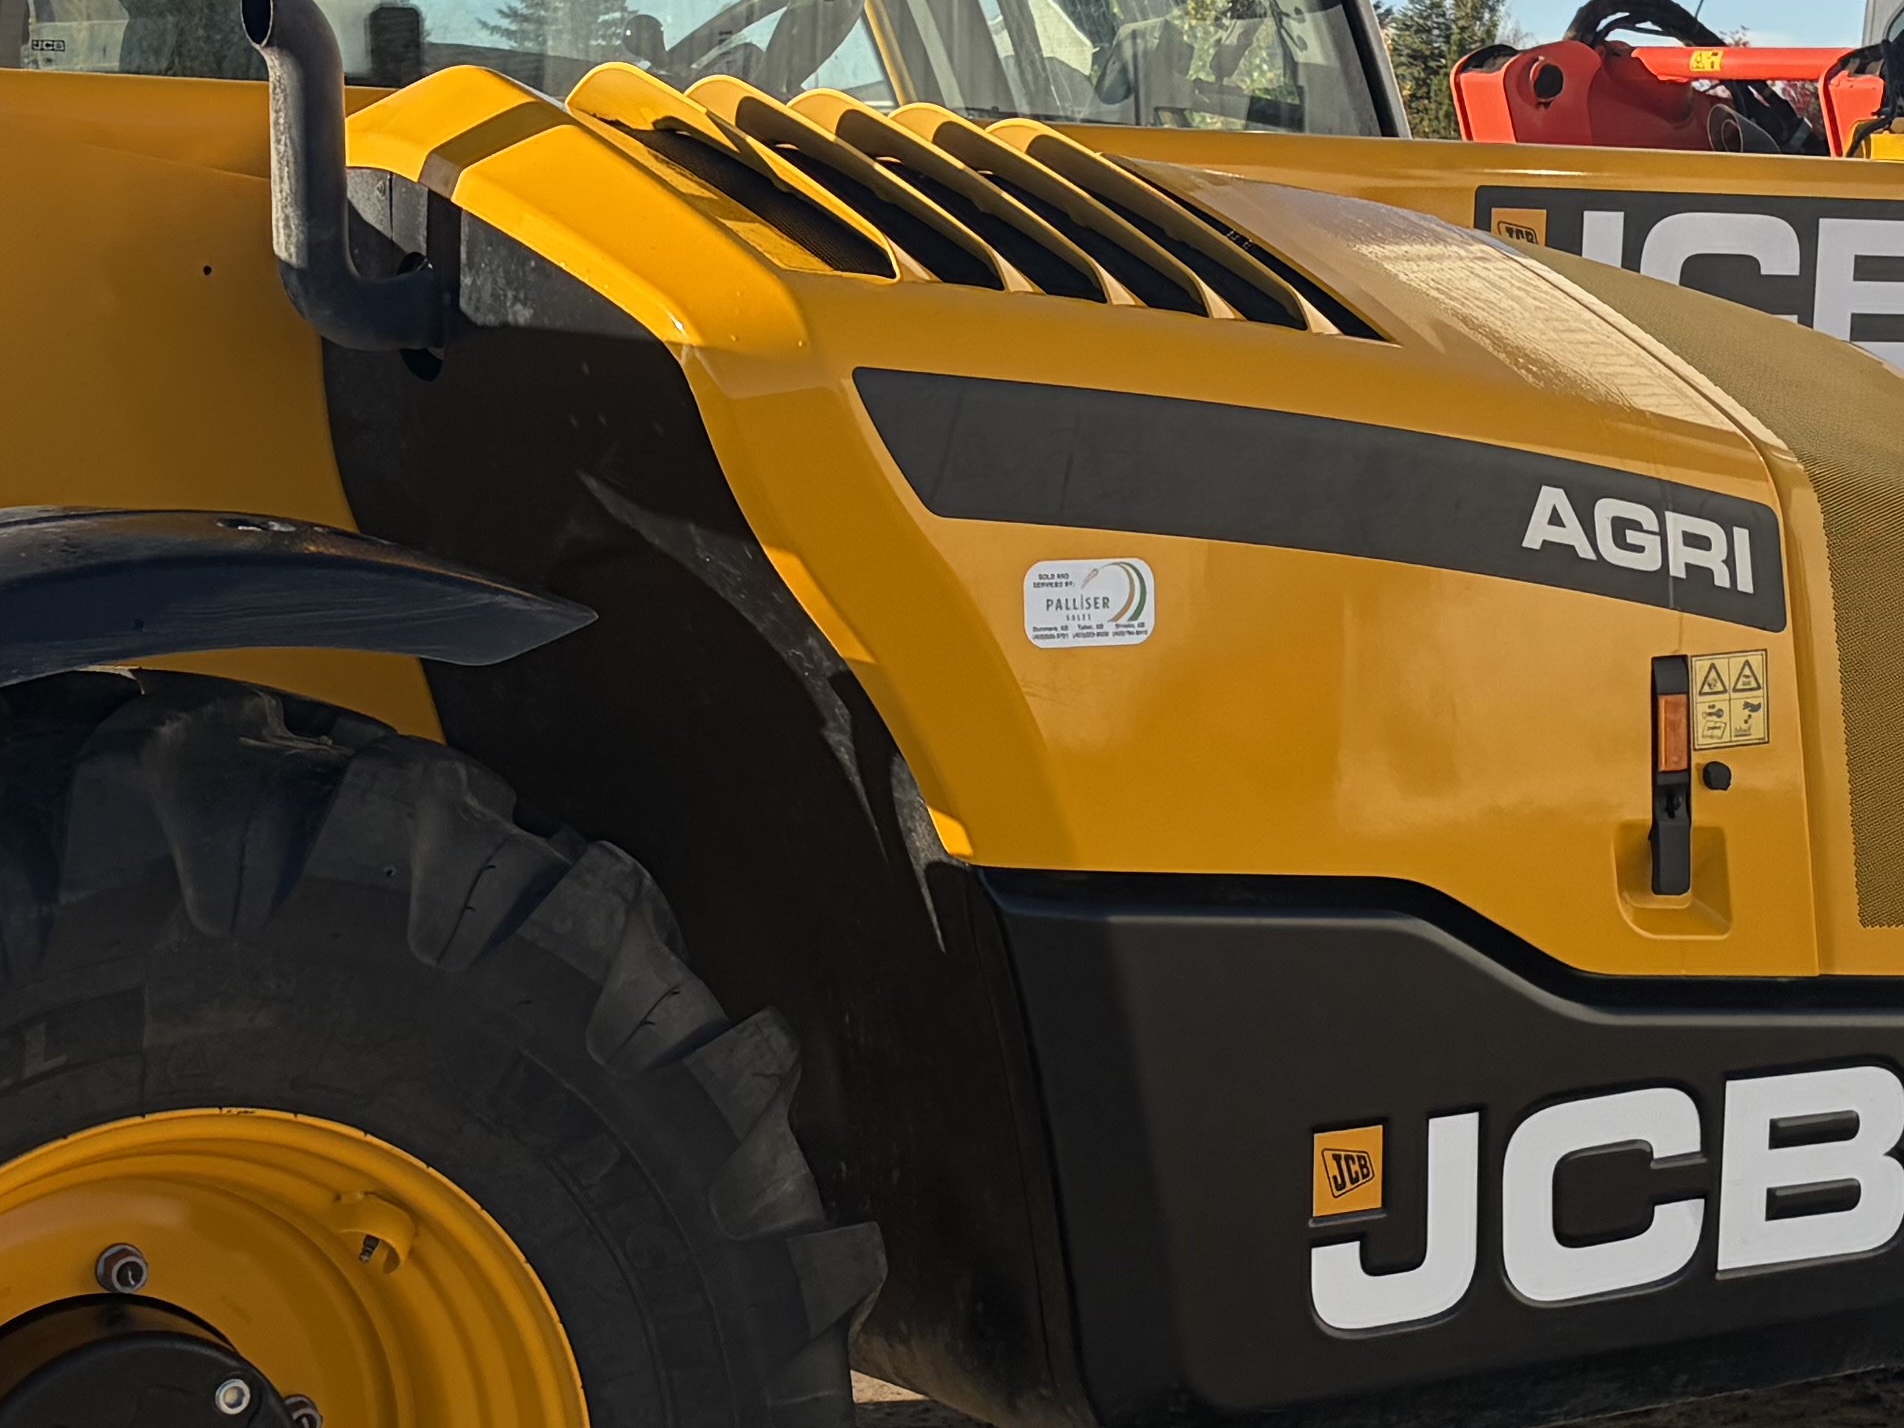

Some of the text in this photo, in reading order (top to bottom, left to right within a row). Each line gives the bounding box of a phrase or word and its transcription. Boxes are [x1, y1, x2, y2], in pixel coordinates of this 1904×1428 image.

[31, 40, 65, 52] JCB
[1521, 484, 1755, 595] AGRI
[1045, 594, 1111, 612] PALLISER
[1331, 1153, 1371, 1192] JCB
